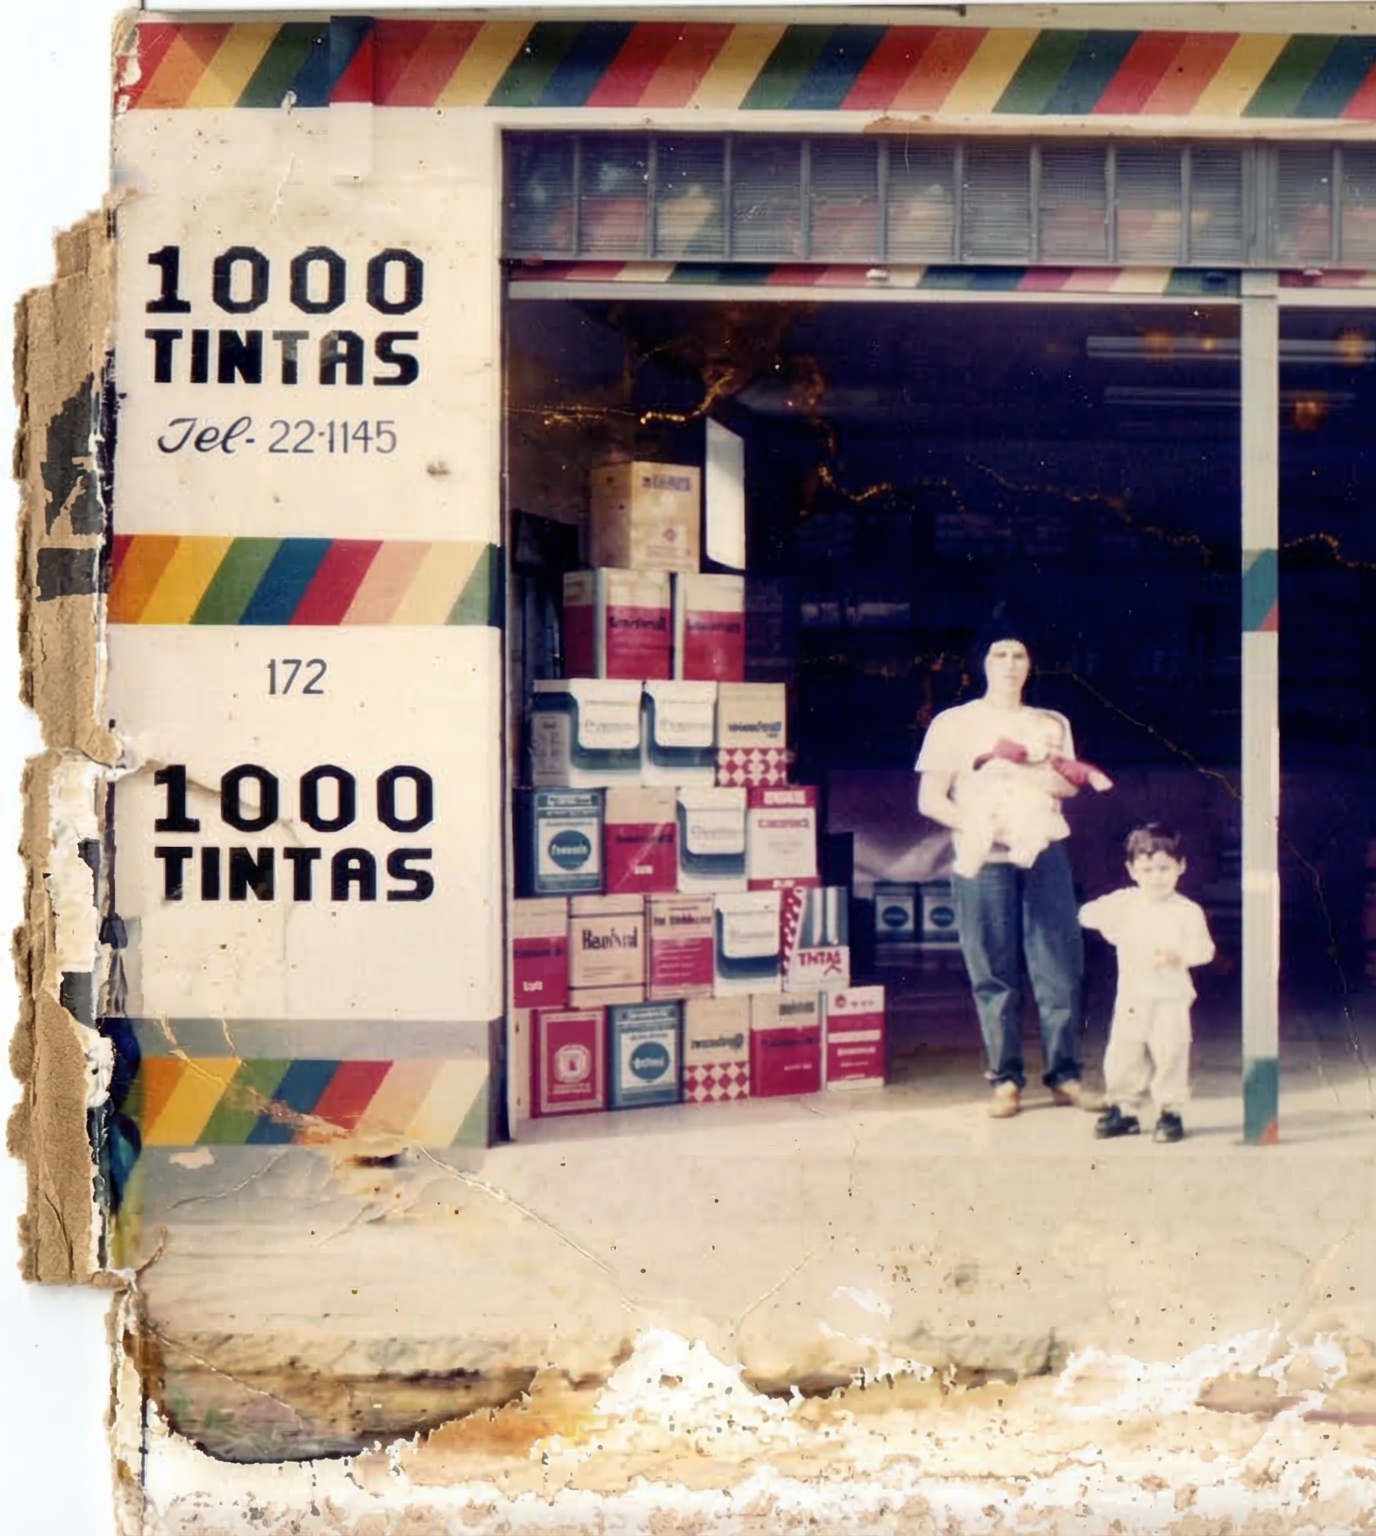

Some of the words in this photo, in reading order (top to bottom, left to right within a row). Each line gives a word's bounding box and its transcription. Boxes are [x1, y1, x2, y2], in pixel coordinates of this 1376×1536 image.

[145, 245, 424, 315] 1000
[145, 329, 419, 386] TINTAS
[266, 658, 328, 696] 172
[154, 763, 434, 833] 1000
[154, 846, 435, 901] TINTAS
